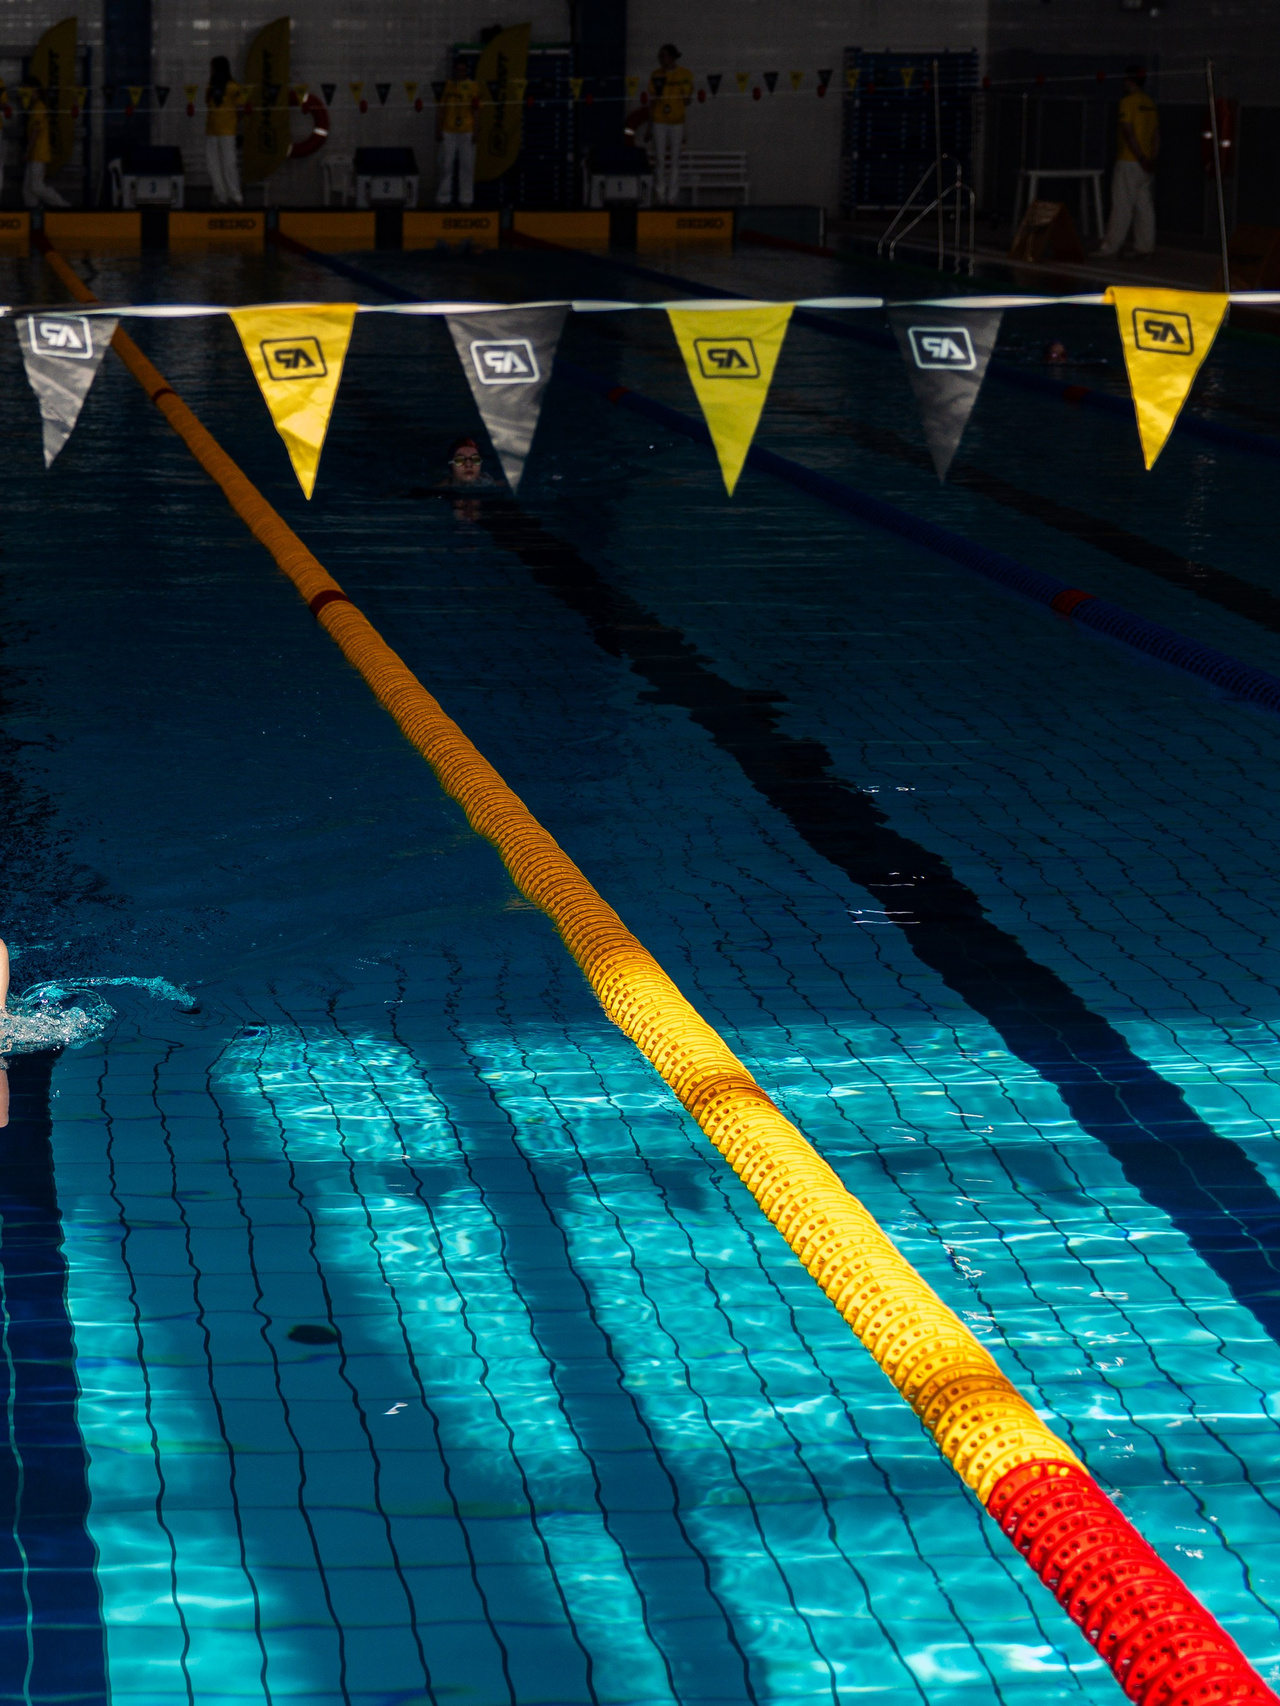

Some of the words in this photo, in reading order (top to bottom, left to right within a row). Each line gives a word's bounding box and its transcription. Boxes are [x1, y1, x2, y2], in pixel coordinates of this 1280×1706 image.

[207, 218, 257, 231] SEIKO
[442, 217, 491, 230] SEIKO
[676, 217, 726, 230] SEIKO
